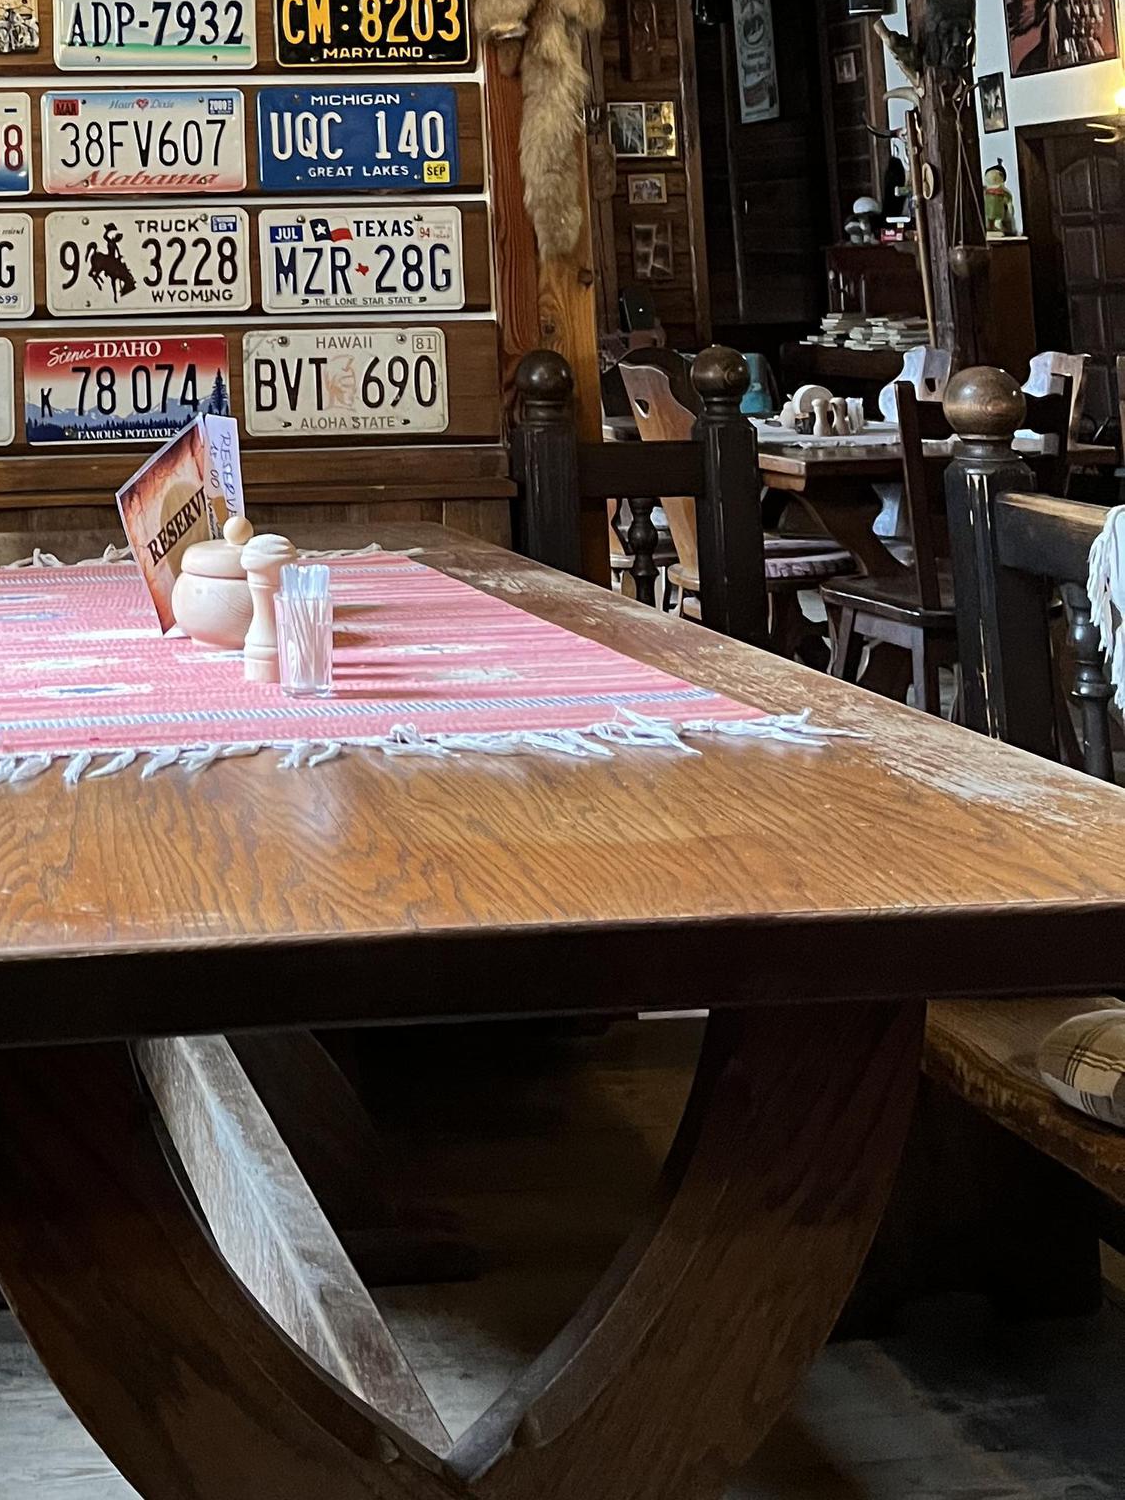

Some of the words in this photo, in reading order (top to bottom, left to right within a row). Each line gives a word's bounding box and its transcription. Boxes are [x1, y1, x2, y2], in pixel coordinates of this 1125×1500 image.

[67, 1, 244, 47] ADP-7932
[322, 47, 424, 60] MARYLAND
[310, 93, 401, 107] MICHIGAN
[269, 112, 344, 162] UQC
[374, 110, 445, 161] 140
[59, 118, 227, 169] 38FV607
[65, 169, 220, 188] Alabama
[308, 166, 355, 178] GREAT
[363, 165, 410, 177] LAKES
[426, 166, 447, 177] SEP
[135, 218, 200, 234] TRUCK
[353, 219, 415, 238] TEXAS
[419, 226, 431, 239] 94
[274, 228, 300, 241] JUL
[274, 246, 353, 296] MZR
[374, 242, 452, 293] 28G
[151, 288, 234, 304] WYOMING
[314, 297, 331, 306] THE
[334, 297, 357, 306] LONE
[362, 296, 384, 305] STAR
[387, 295, 414, 305] STATE
[315, 336, 373, 350] HAWAII
[414, 337, 435, 350] 81
[46, 345, 94, 367] Scenic
[92, 340, 162, 358] IDAHO
[253, 357, 328, 412] BVT
[361, 354, 438, 409] 690
[300, 417, 348, 429] ALOHA
[351, 416, 395, 428] STATE
[77, 428, 123, 440] FAMOUS
[125, 426, 180, 438] POTATOES
